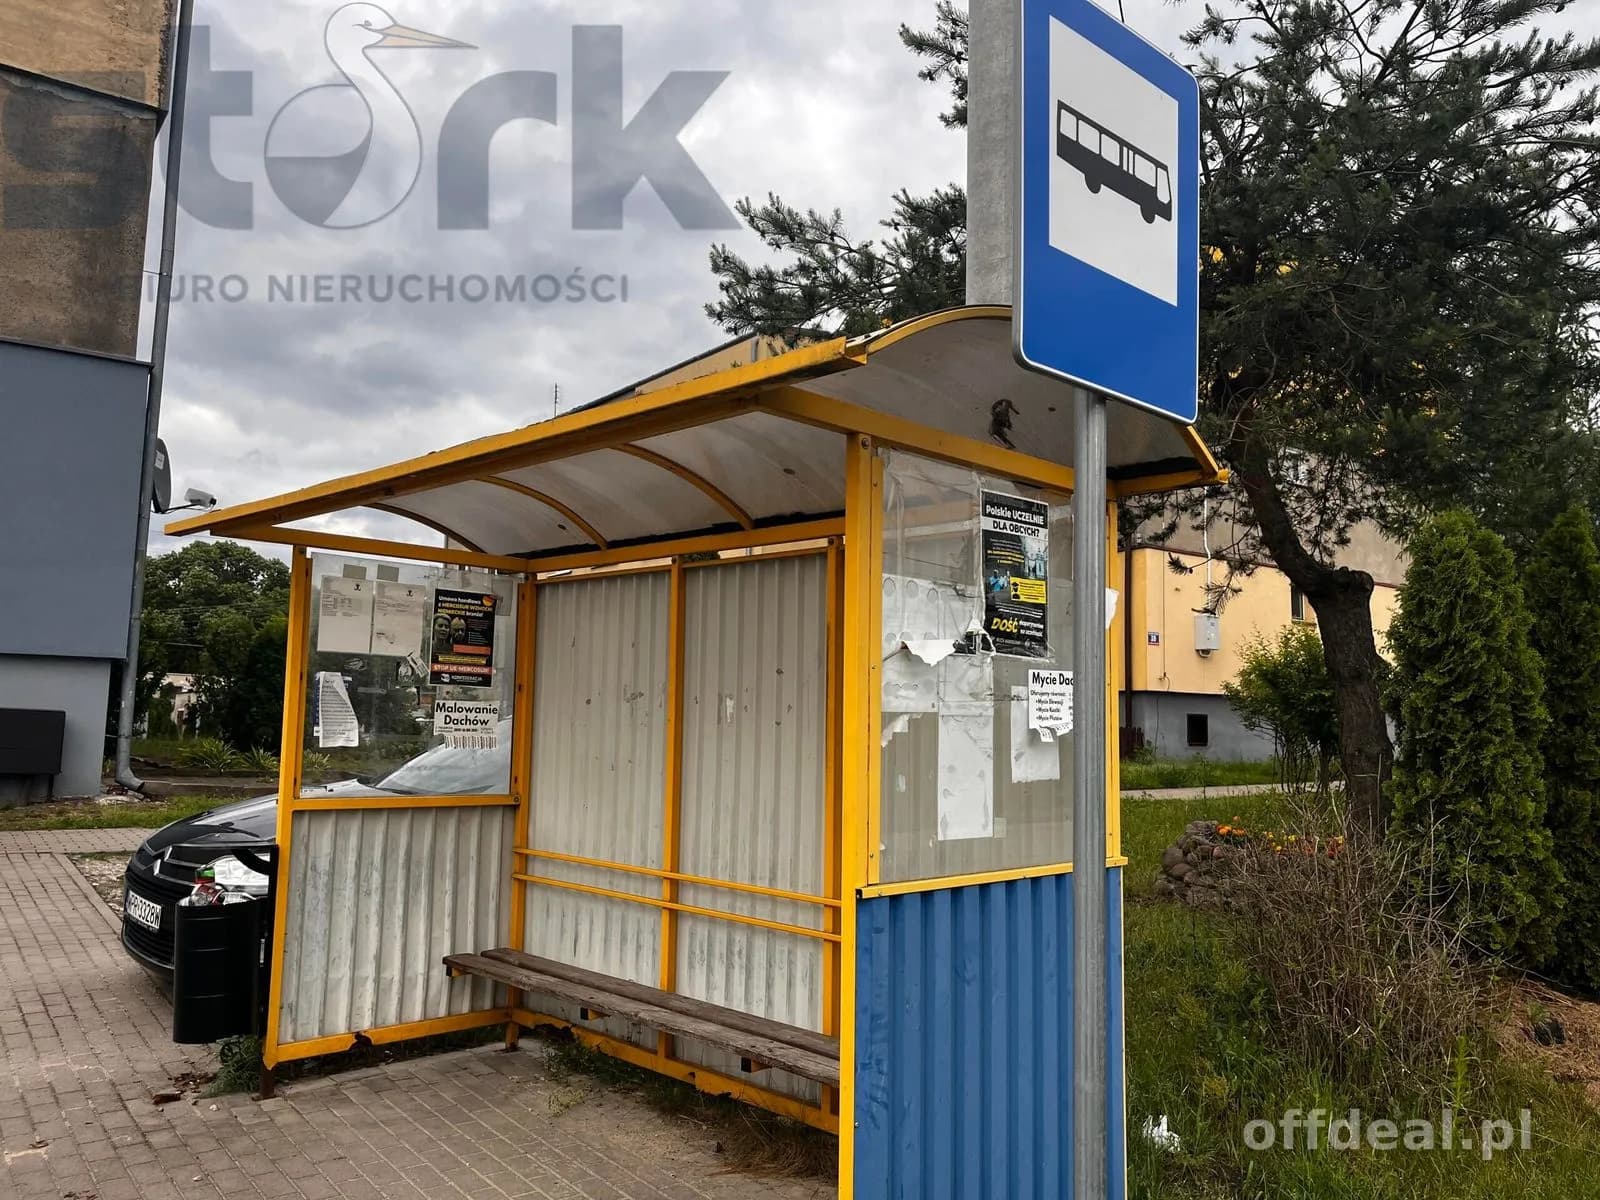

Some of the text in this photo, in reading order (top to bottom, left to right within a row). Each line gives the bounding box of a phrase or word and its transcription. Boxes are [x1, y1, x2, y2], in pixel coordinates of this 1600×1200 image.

[985, 504, 1045, 526] Polskie UCZELNIE
[992, 519, 1040, 538] DLA OBCYCH?
[991, 616, 1018, 633] DOŚĆ
[1032, 672, 1057, 688] Mycie
[435, 702, 498, 715] Malowanie
[443, 714, 490, 727] Dachów
